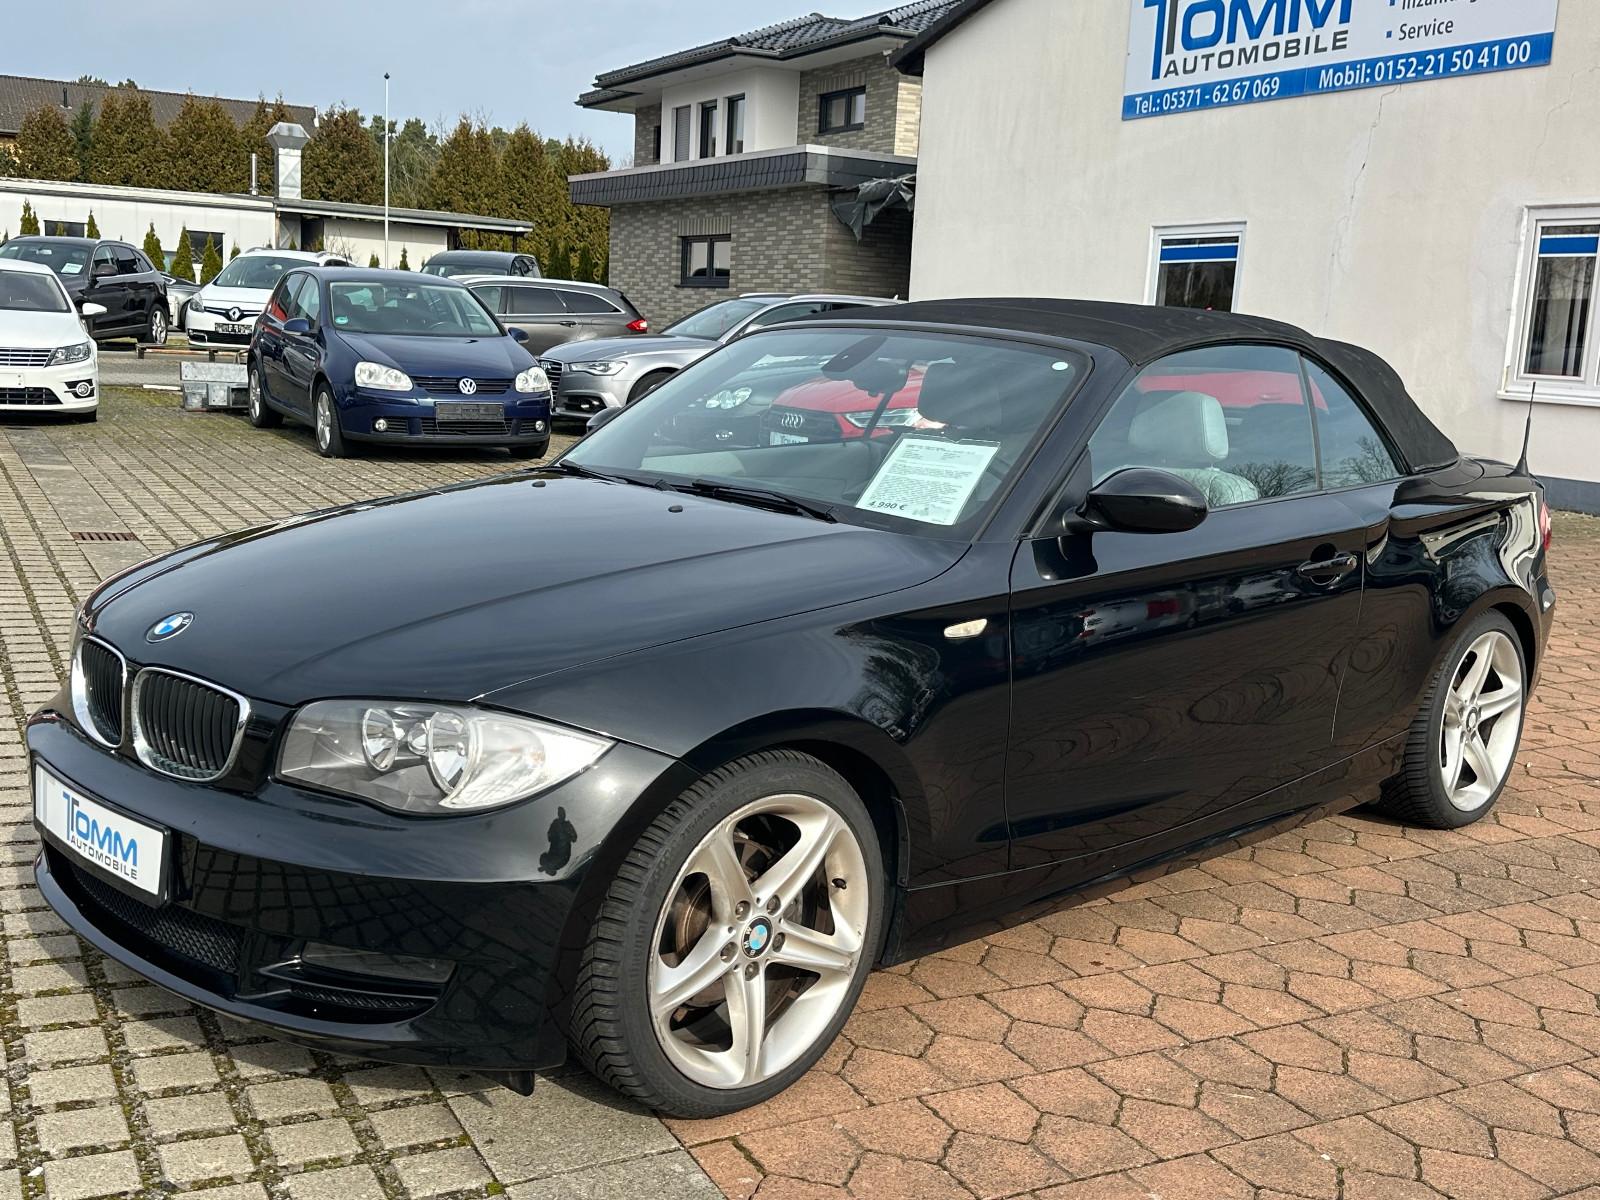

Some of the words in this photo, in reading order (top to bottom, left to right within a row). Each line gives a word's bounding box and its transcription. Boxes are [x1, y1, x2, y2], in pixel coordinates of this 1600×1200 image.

[1398, 18, 1454, 41] Service
[1163, 30, 1349, 78] AUTOMOBILE
[1318, 63, 1371, 89] Mobil:
[1374, 53, 1445, 82] 0152-21
[1450, 49, 1474, 72] 50
[1477, 45, 1500, 68] 41
[1506, 40, 1531, 65] 00
[1135, 95, 1160, 114] Tel.:
[1162, 88, 1201, 110] 05371
[1212, 84, 1229, 104] 62
[1232, 81, 1250, 100] 67
[1252, 76, 1280, 98] 069
[62, 791, 138, 867] TOMM
[70, 834, 138, 880] AUTOMOBILE
